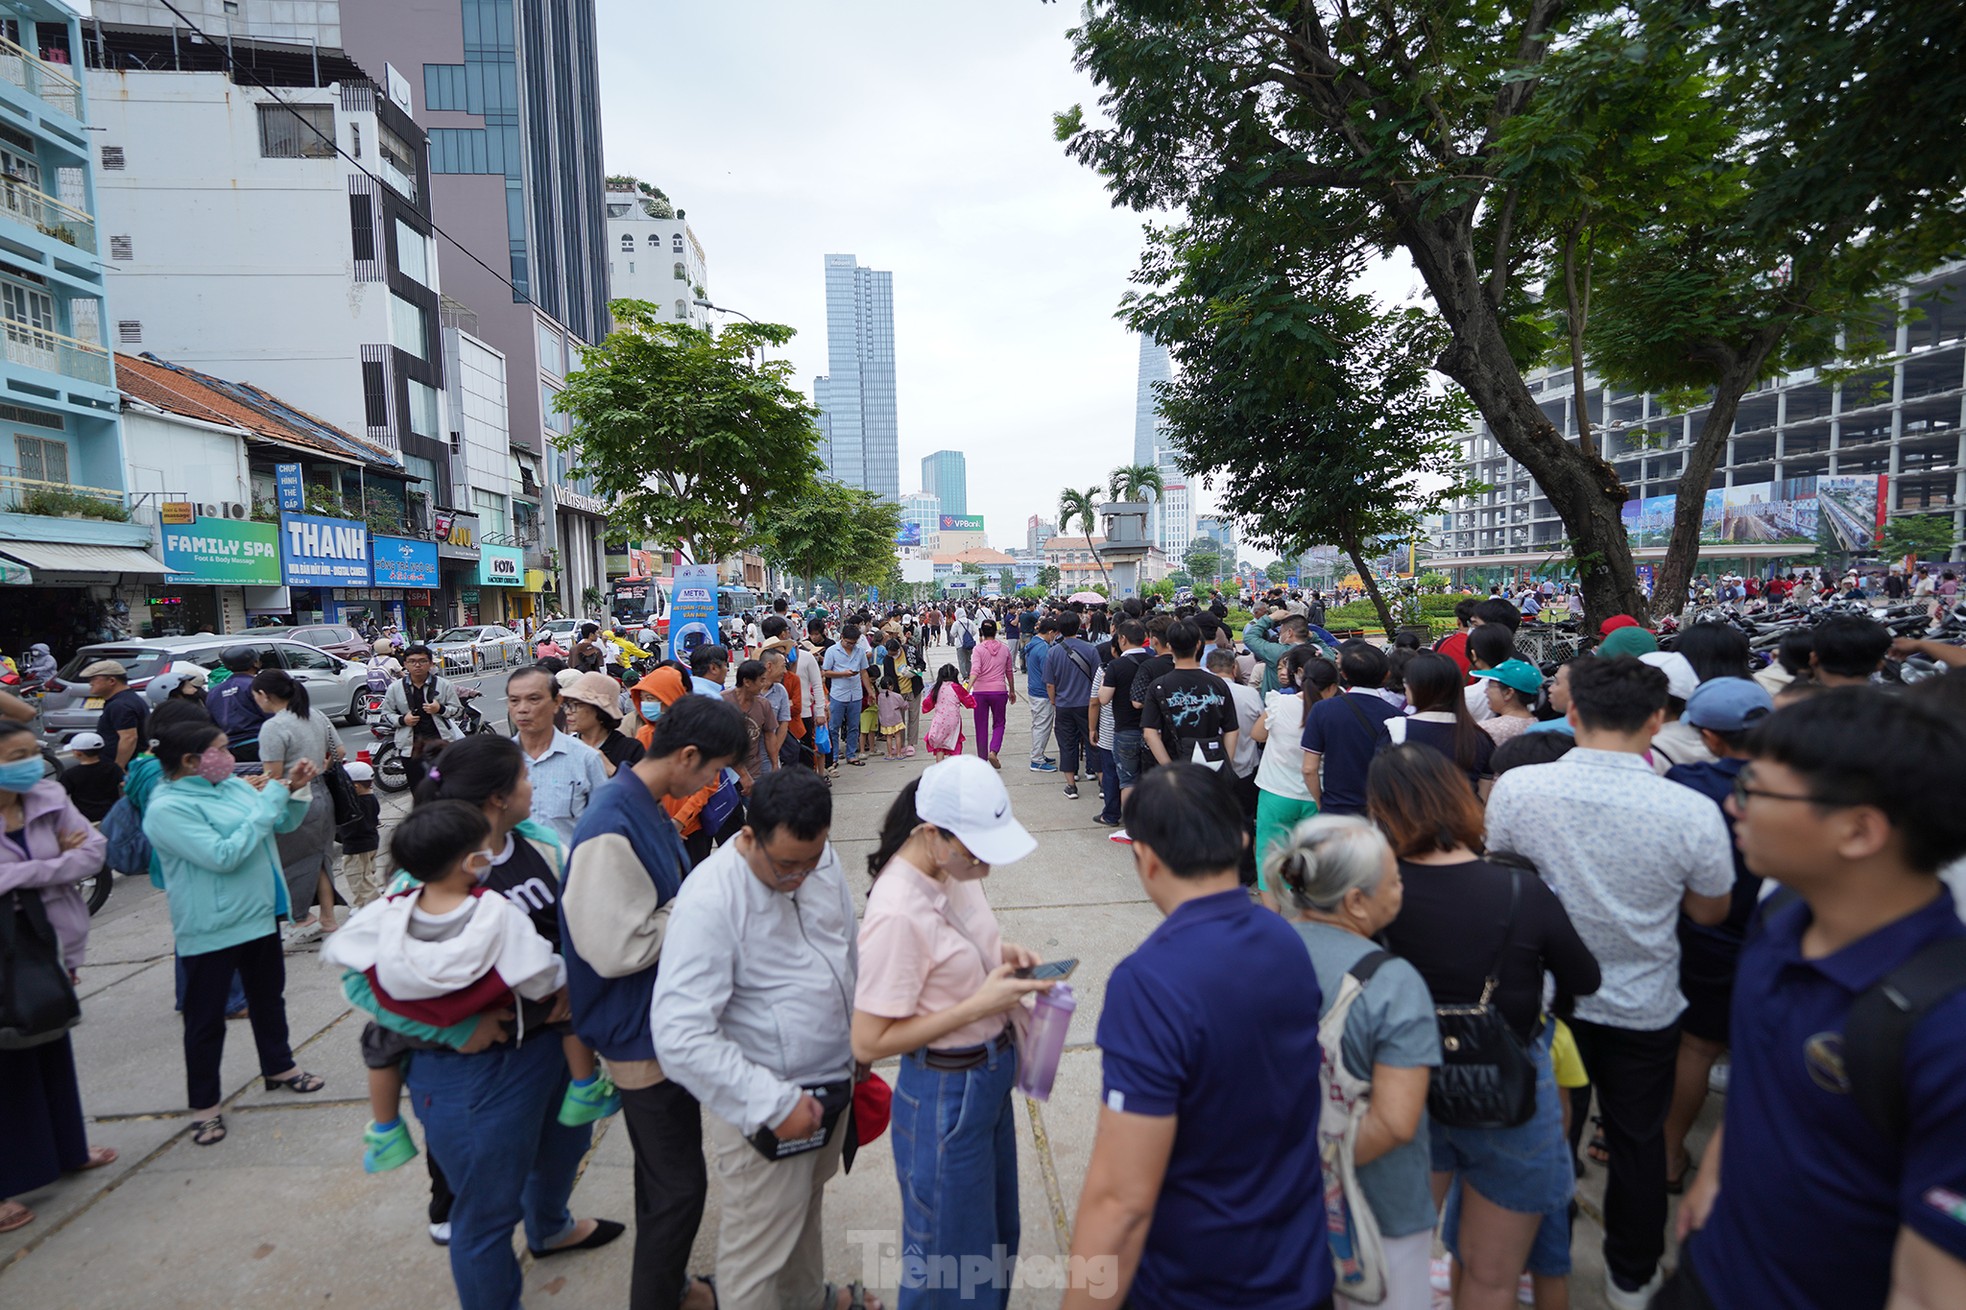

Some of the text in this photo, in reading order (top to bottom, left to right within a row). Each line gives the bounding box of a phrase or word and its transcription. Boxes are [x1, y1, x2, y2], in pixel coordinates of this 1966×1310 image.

[279, 464, 296, 474] CHỤP
[281, 476, 298, 484] HÌNH
[954, 520, 980, 528] VPBank
[288, 521, 366, 560] THANH
[167, 535, 275, 558] FAMILY SPA
